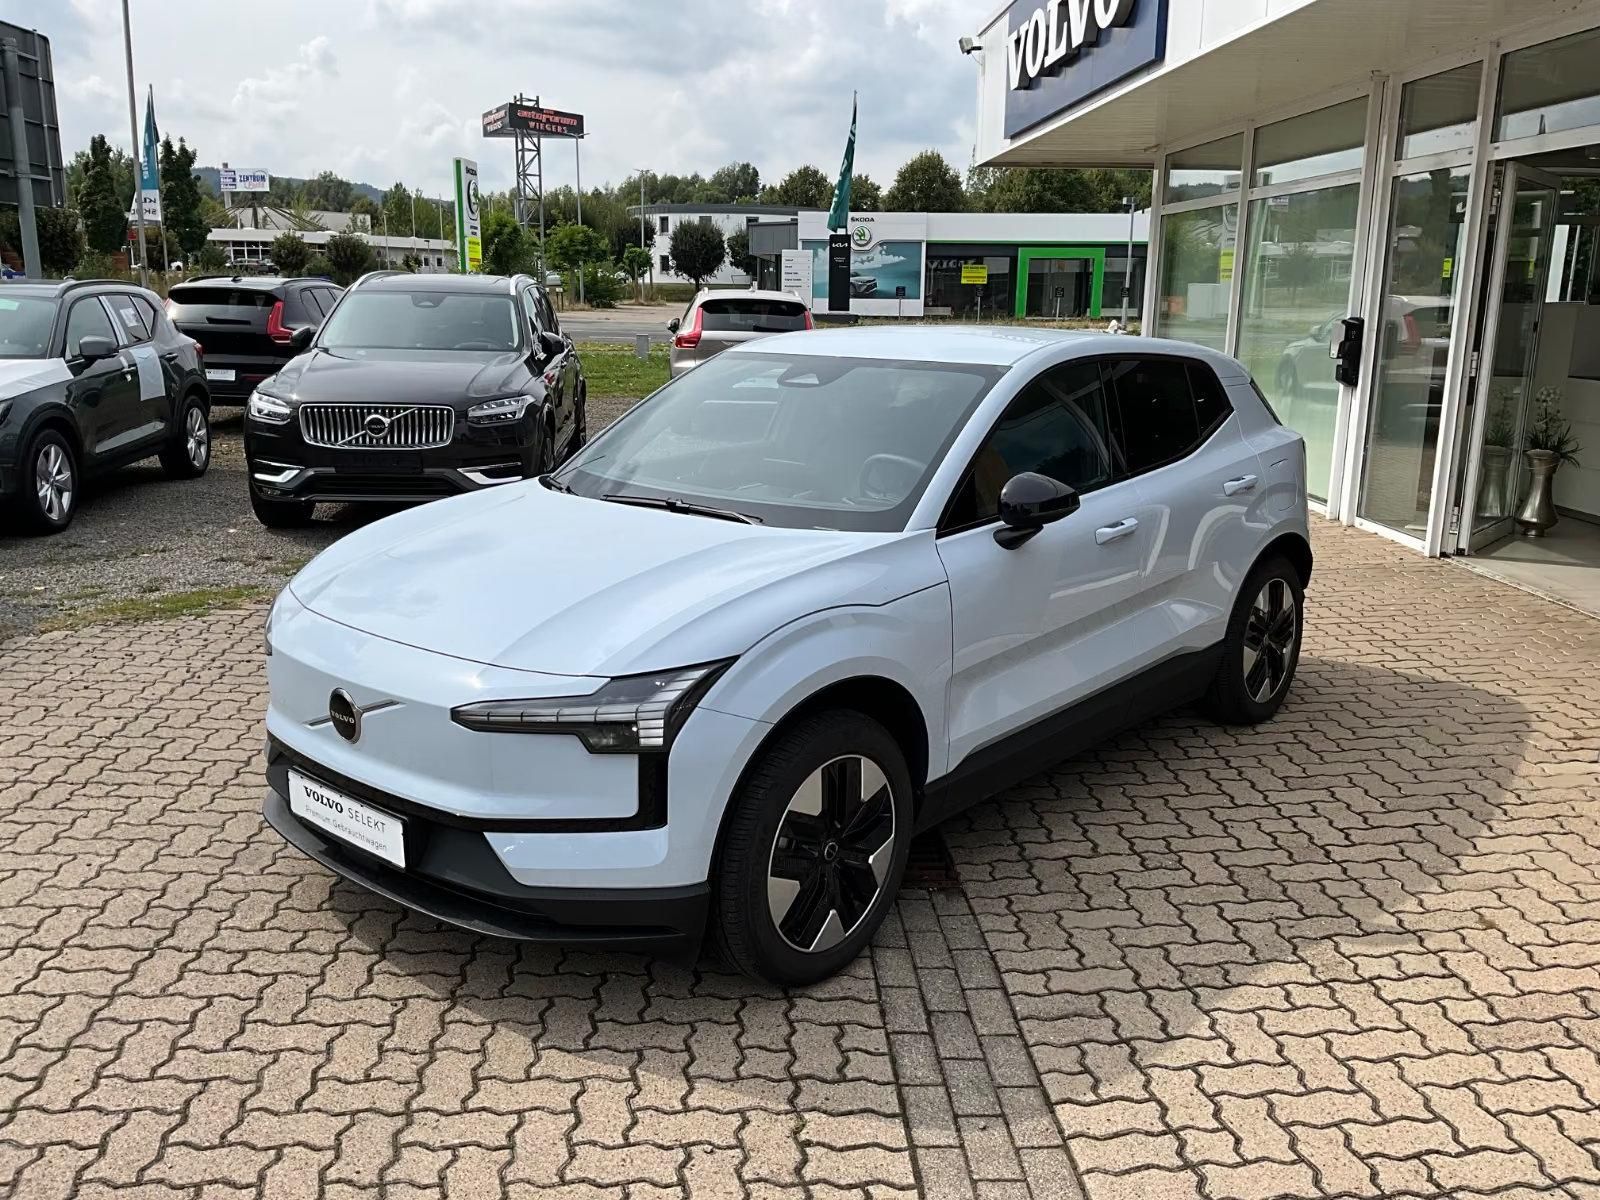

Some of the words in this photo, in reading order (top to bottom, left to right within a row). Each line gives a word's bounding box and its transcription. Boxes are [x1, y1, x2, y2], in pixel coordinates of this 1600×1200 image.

[1007, 0, 1119, 90] VOLVO
[528, 121, 568, 133] WIEGERS
[239, 174, 266, 182] ZENTRUM
[331, 710, 355, 724] VOLVO
[303, 785, 344, 814] VOLVO
[347, 807, 386, 833] SELEKT
[305, 804, 333, 824] Premium
[332, 818, 388, 852] Gebrauchtwagen
